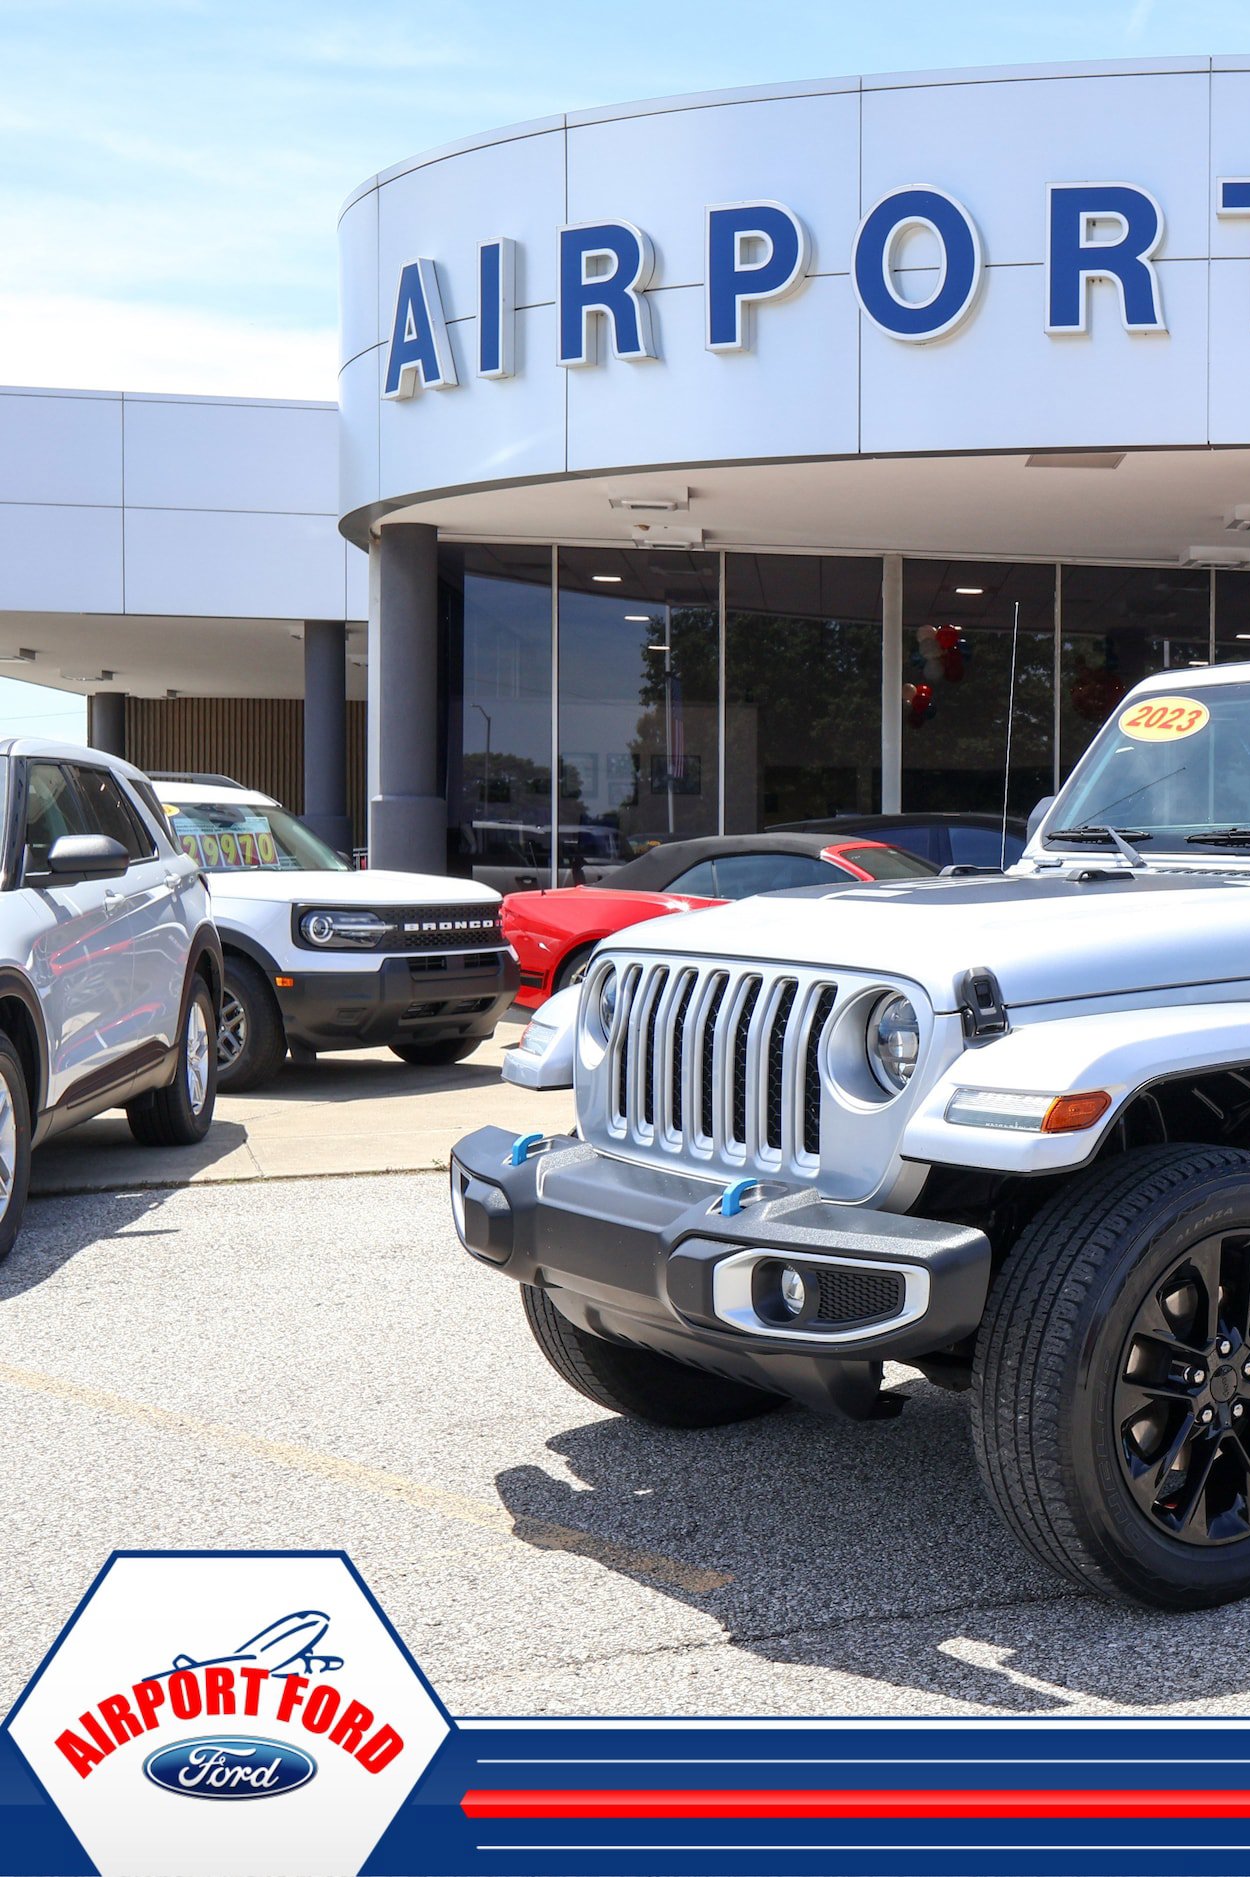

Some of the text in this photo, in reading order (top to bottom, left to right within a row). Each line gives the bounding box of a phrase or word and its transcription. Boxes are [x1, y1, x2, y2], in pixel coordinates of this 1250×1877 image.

[1125, 706, 1202, 732] 2023
[183, 834, 273, 866] 29970
[404, 920, 494, 931] BRONCO
